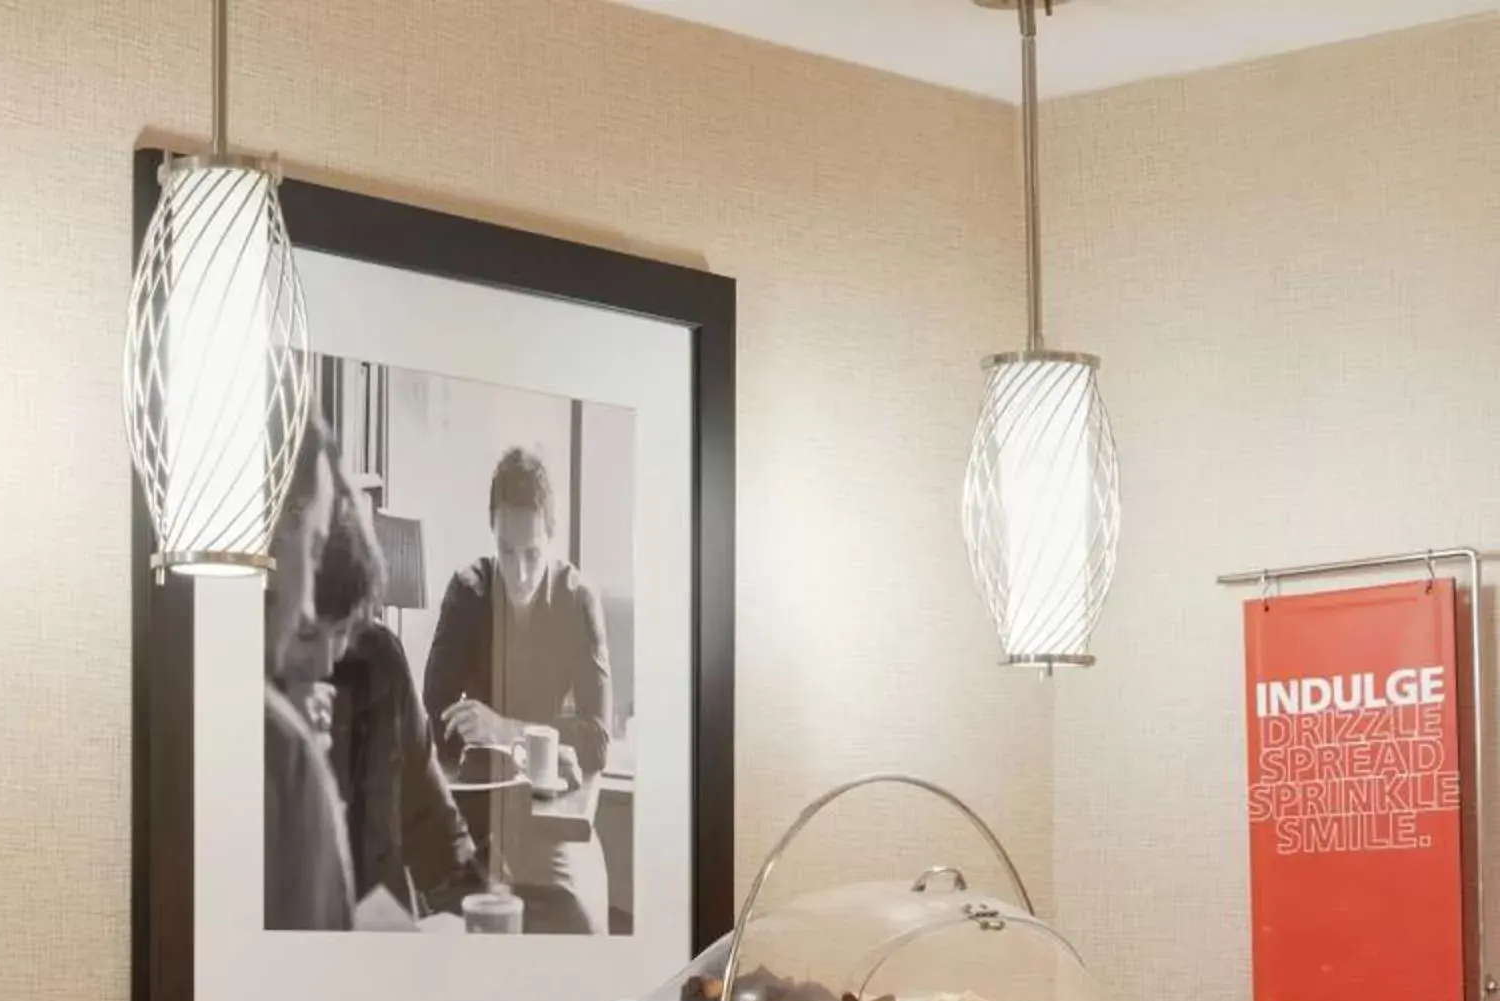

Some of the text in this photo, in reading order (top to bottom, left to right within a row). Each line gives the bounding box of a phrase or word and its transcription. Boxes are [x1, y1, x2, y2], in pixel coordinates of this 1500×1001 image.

[1255, 666, 1445, 718] INDULGE
[1262, 702, 1444, 749] DRIZZLE
[1259, 737, 1445, 784] SPREAD
[1246, 770, 1461, 822] SPRINKLE
[1276, 811, 1432, 855] SMILE.
